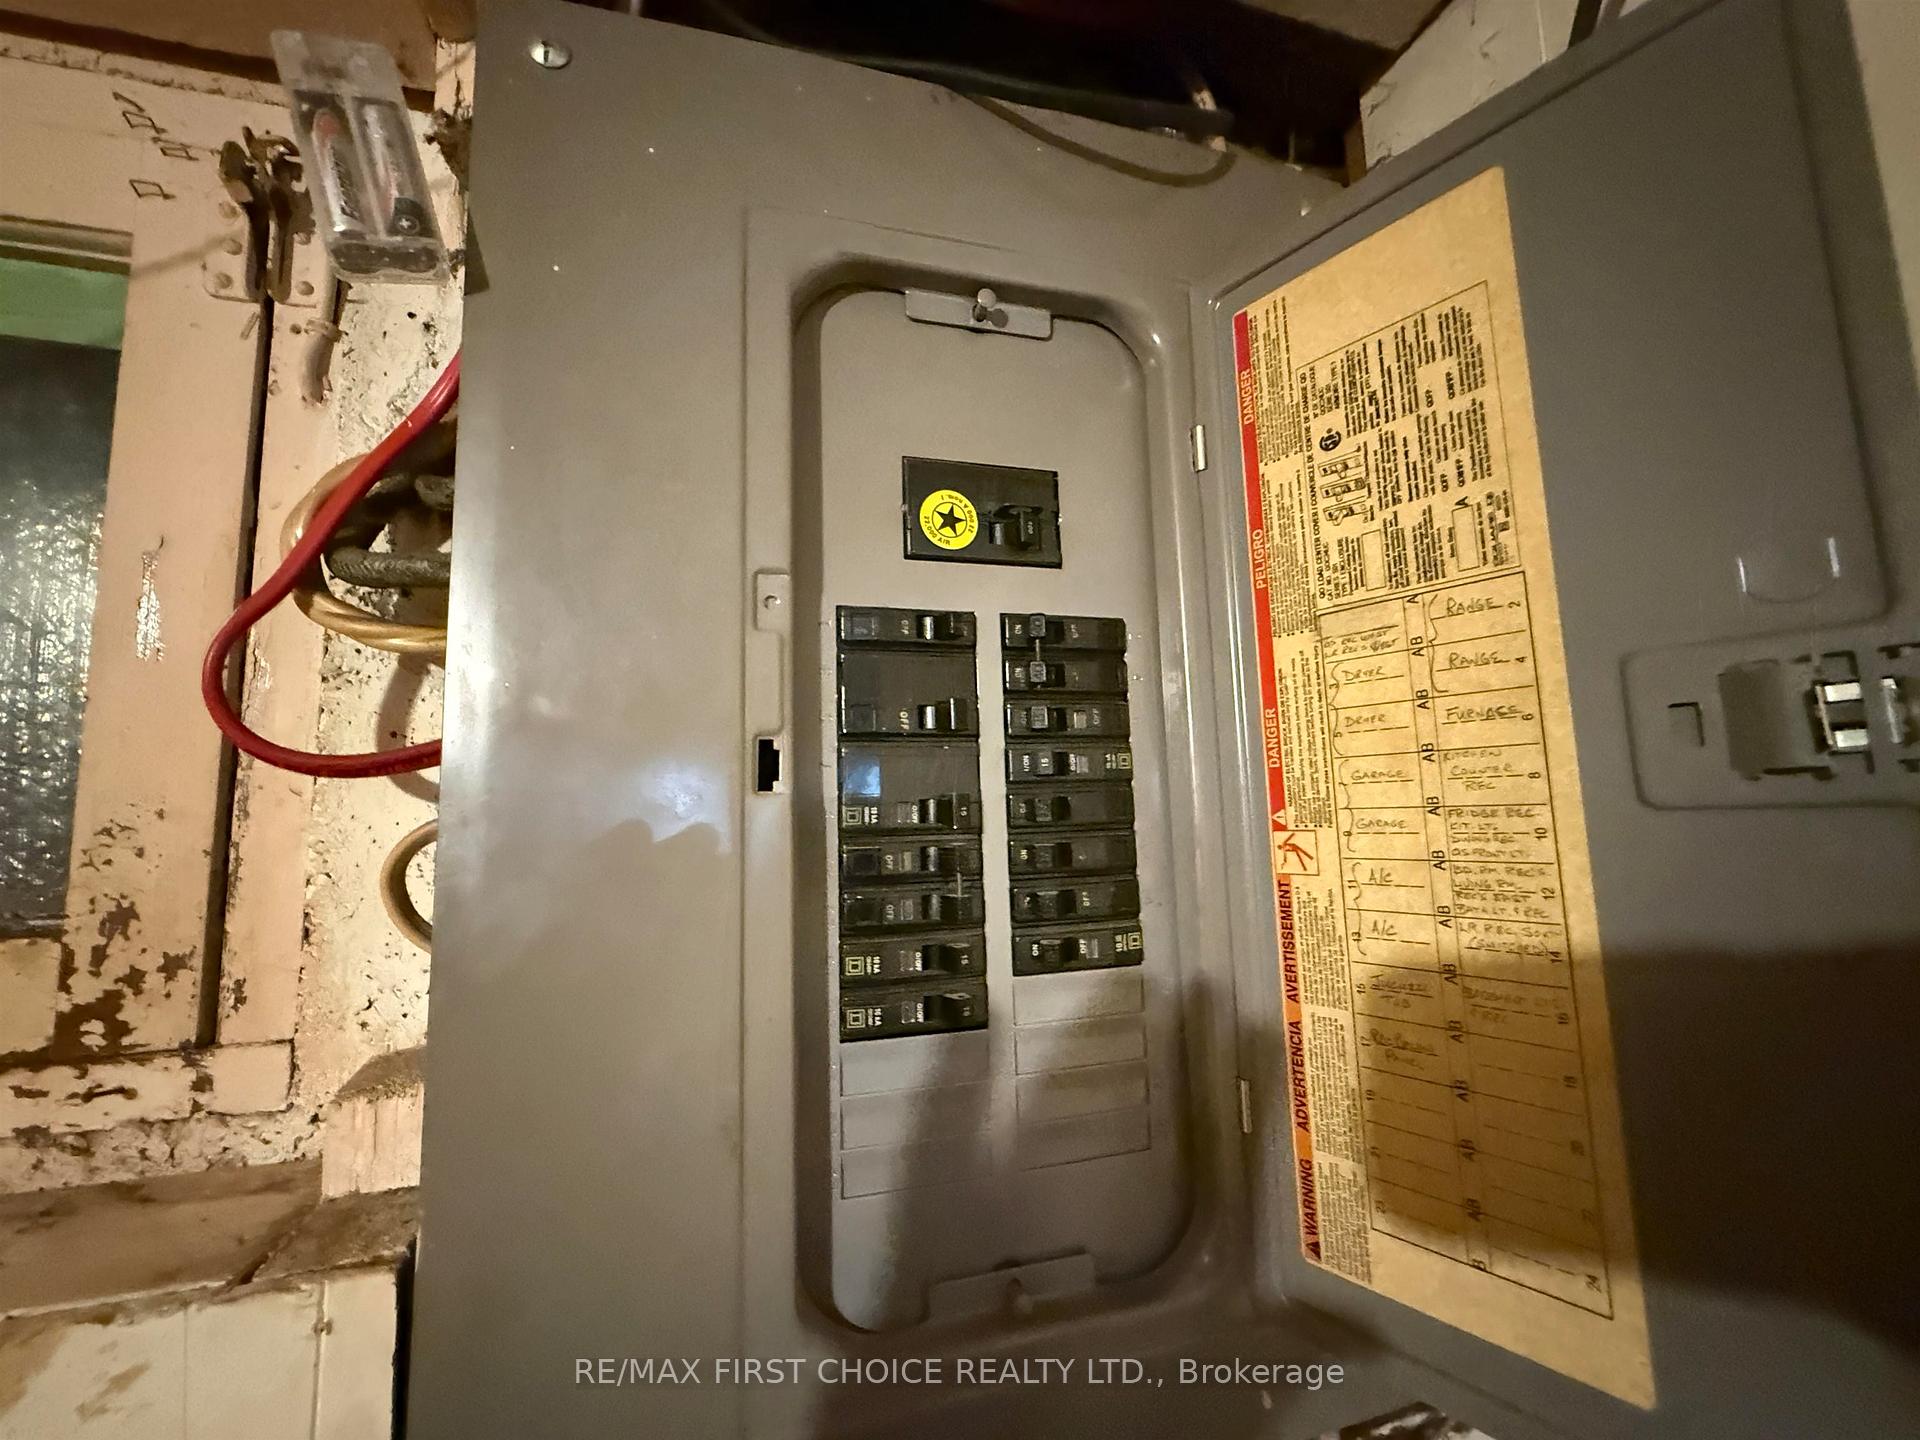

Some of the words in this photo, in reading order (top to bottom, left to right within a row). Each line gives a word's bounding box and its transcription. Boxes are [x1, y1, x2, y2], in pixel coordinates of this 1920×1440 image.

[1238, 368, 1254, 424] DANGER
[1304, 424, 1313, 452] CENTRE
[1455, 496, 1468, 506] A
[1312, 512, 1320, 536] COVER
[1252, 528, 1268, 588] PELIGRO
[1314, 537, 1322, 565] CENTER
[1337, 538, 1346, 576] ENCLOSURE
[1318, 587, 1326, 599] QO
[1446, 597, 1500, 616] RANGE
[1448, 651, 1503, 669] RANGE
[899, 710, 910, 730] OFF
[1445, 706, 1523, 721] FURNACE
[1264, 708, 1280, 768] DANGER
[1352, 770, 1407, 781] GARAGE
[1450, 764, 1514, 776] COUNTER
[1448, 808, 1498, 818] FRIDGE
[1355, 818, 1407, 829] GARAGE
[1032, 943, 1040, 956] ON
[1078, 939, 1087, 954] OFF
[1278, 880, 1299, 1005] AVERTISSEMENT
[1288, 1020, 1311, 1134] ADVERTENCIA
[1300, 1158, 1318, 1236] WARNING
